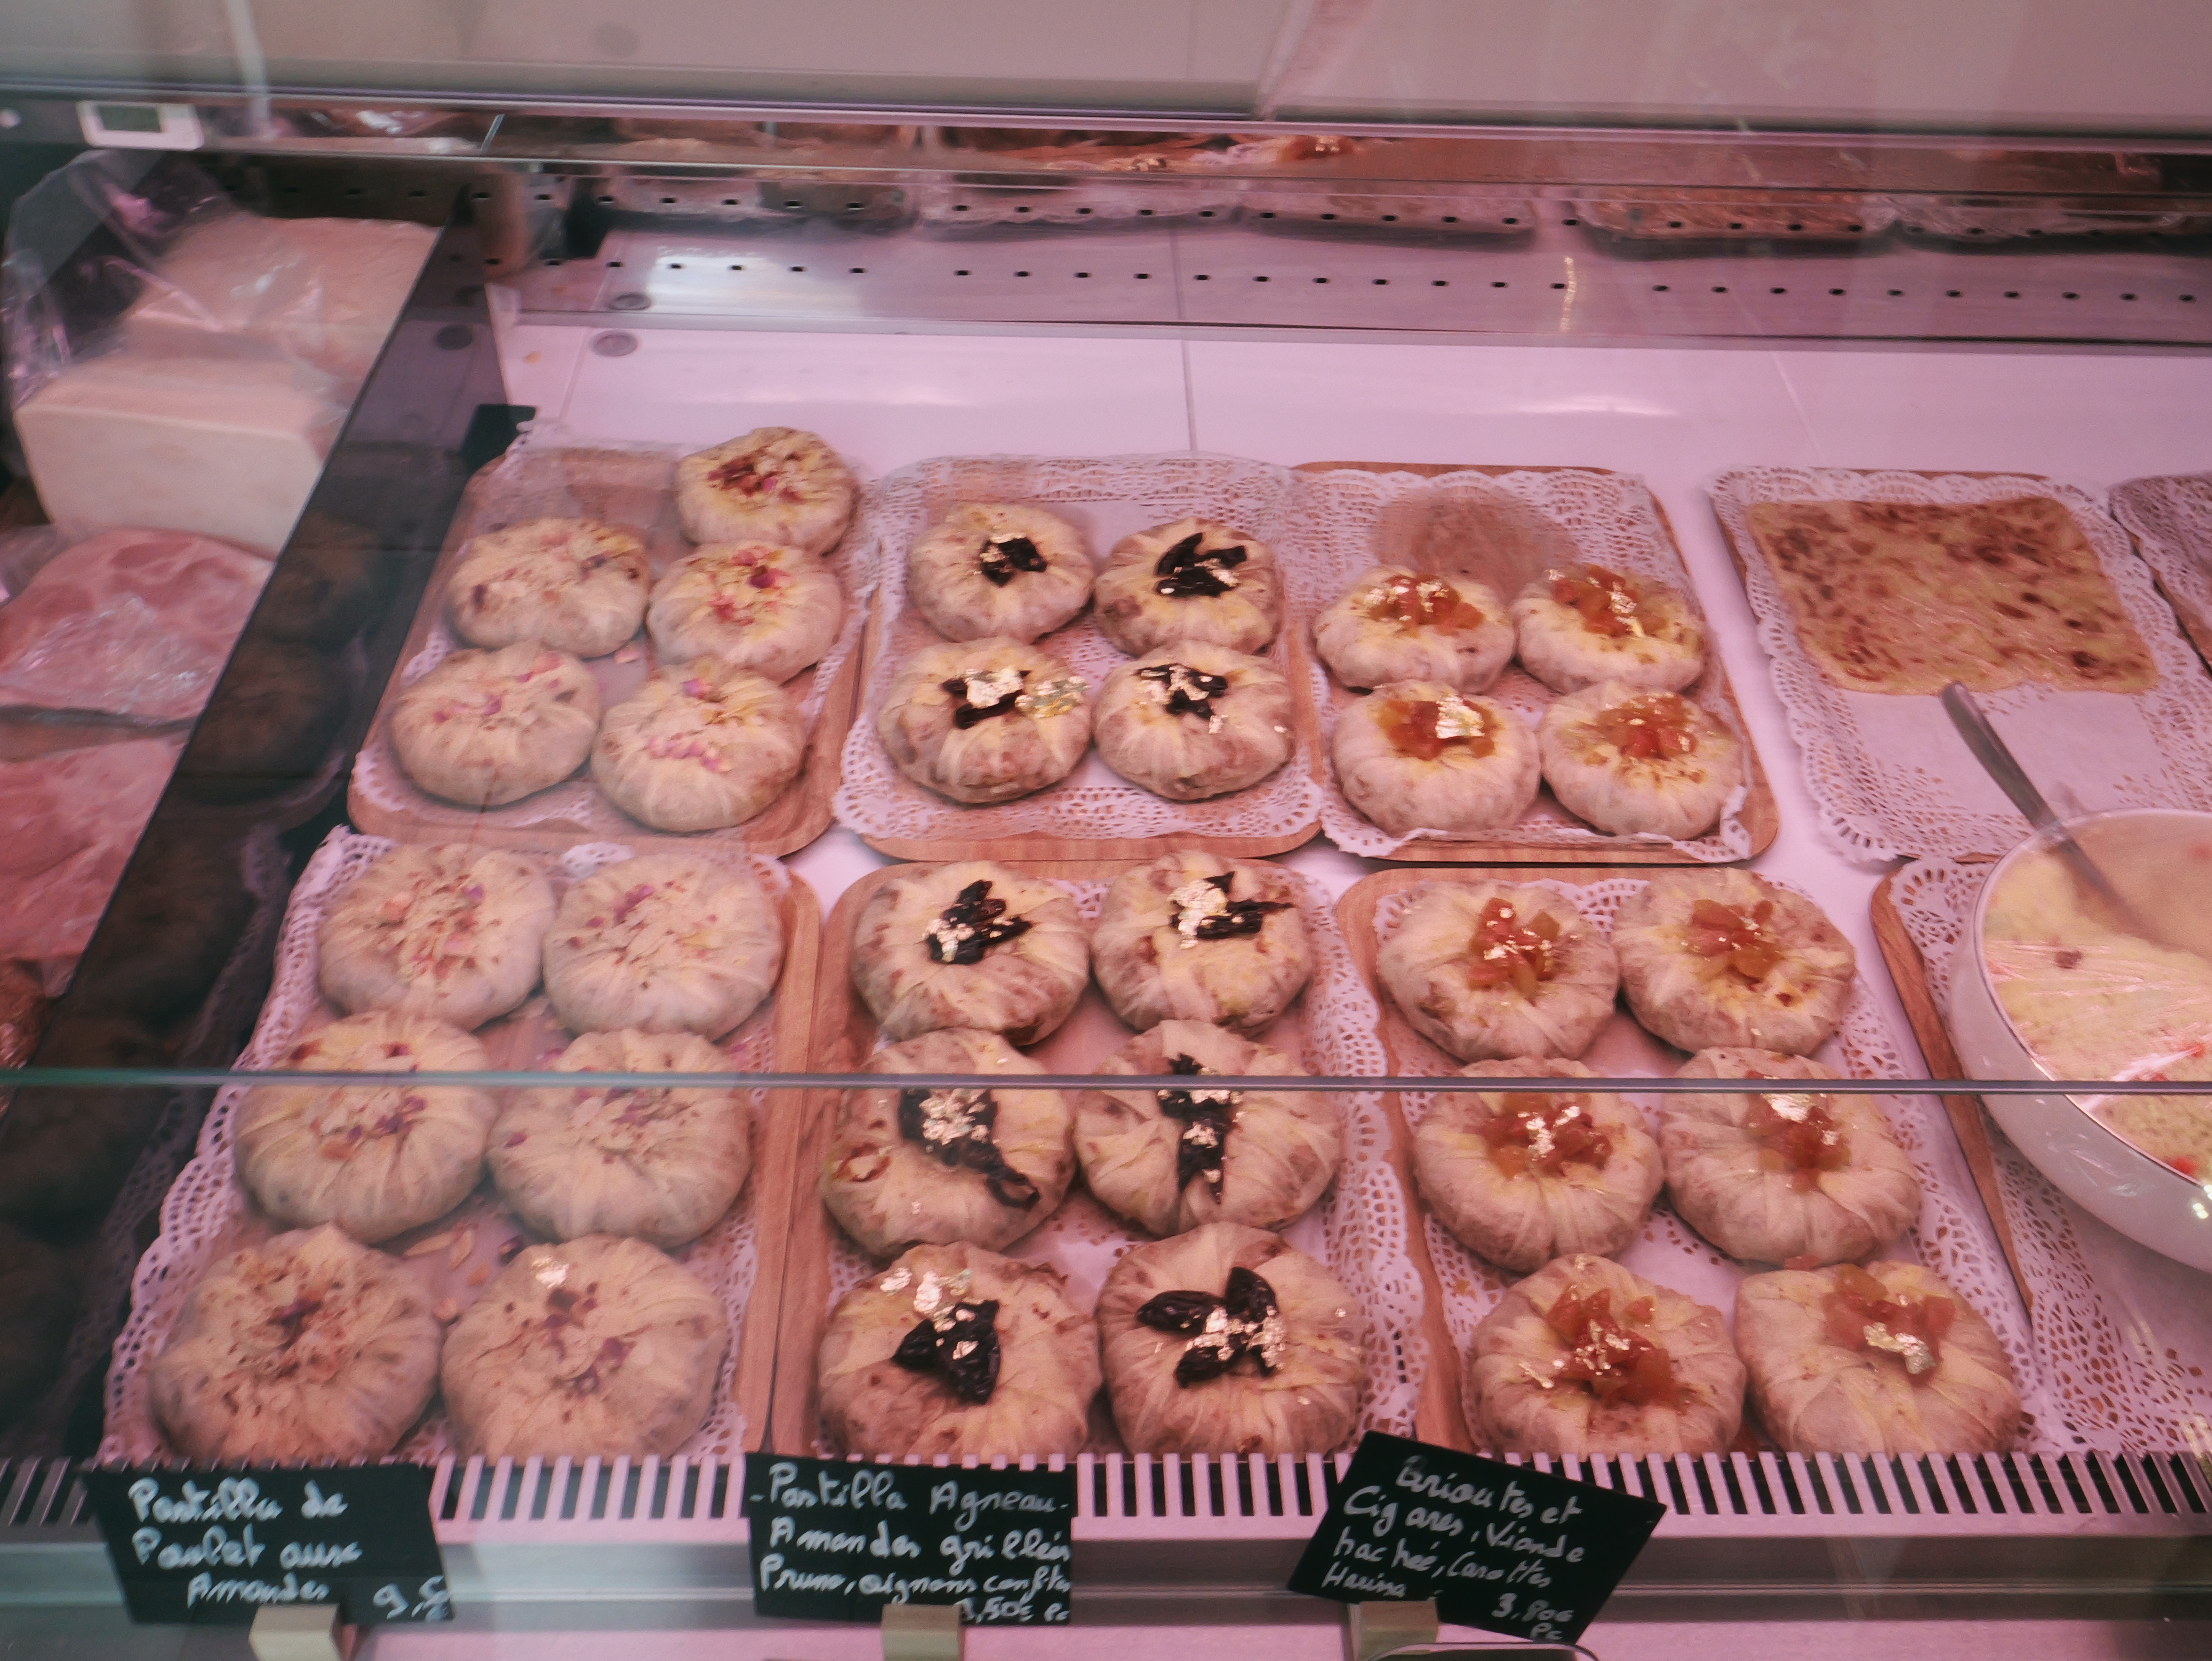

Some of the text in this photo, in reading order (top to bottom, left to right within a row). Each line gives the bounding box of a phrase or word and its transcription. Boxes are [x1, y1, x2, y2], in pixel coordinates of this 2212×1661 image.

[301, 1480, 348, 1519] de
[1540, 1496, 1583, 1524] et
[131, 1522, 363, 1570] Poulet aux
